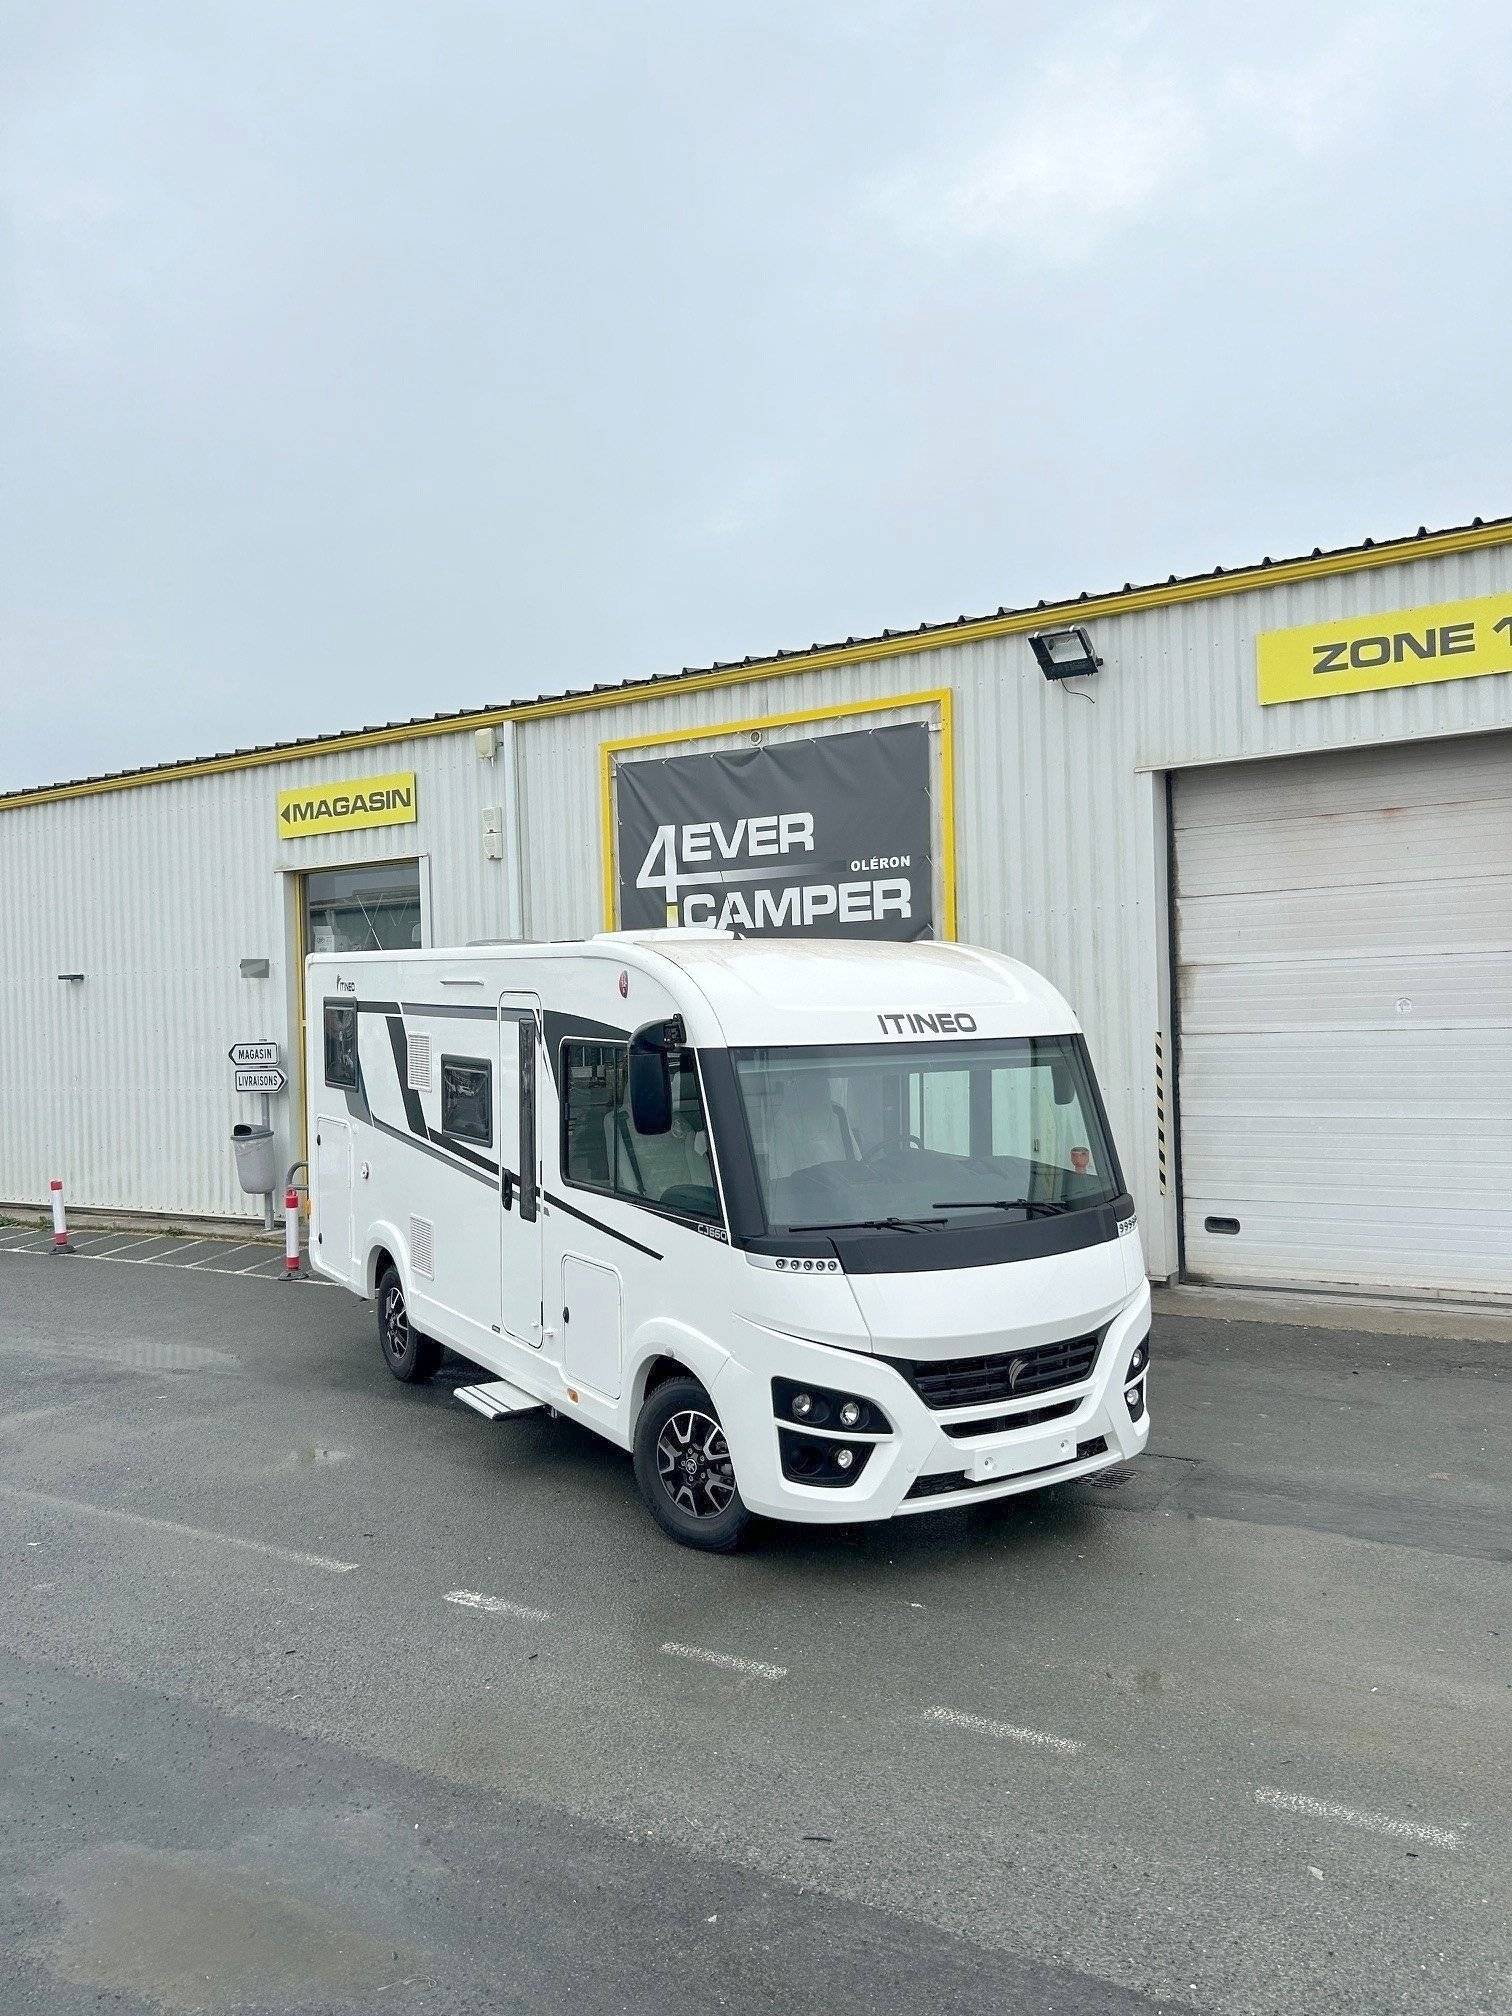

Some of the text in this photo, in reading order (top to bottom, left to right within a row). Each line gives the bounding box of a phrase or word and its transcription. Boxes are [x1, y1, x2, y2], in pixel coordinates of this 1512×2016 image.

[1312, 622, 1476, 674] ZONE
[292, 787, 411, 822] MAGASIN
[850, 855, 911, 872] OLÉRON
[876, 1012, 978, 1035] ITINEO
[238, 1048, 272, 1060] MAGASIN
[238, 1075, 278, 1087] LIVRAISONS
[697, 1224, 727, 1241] CJ660
